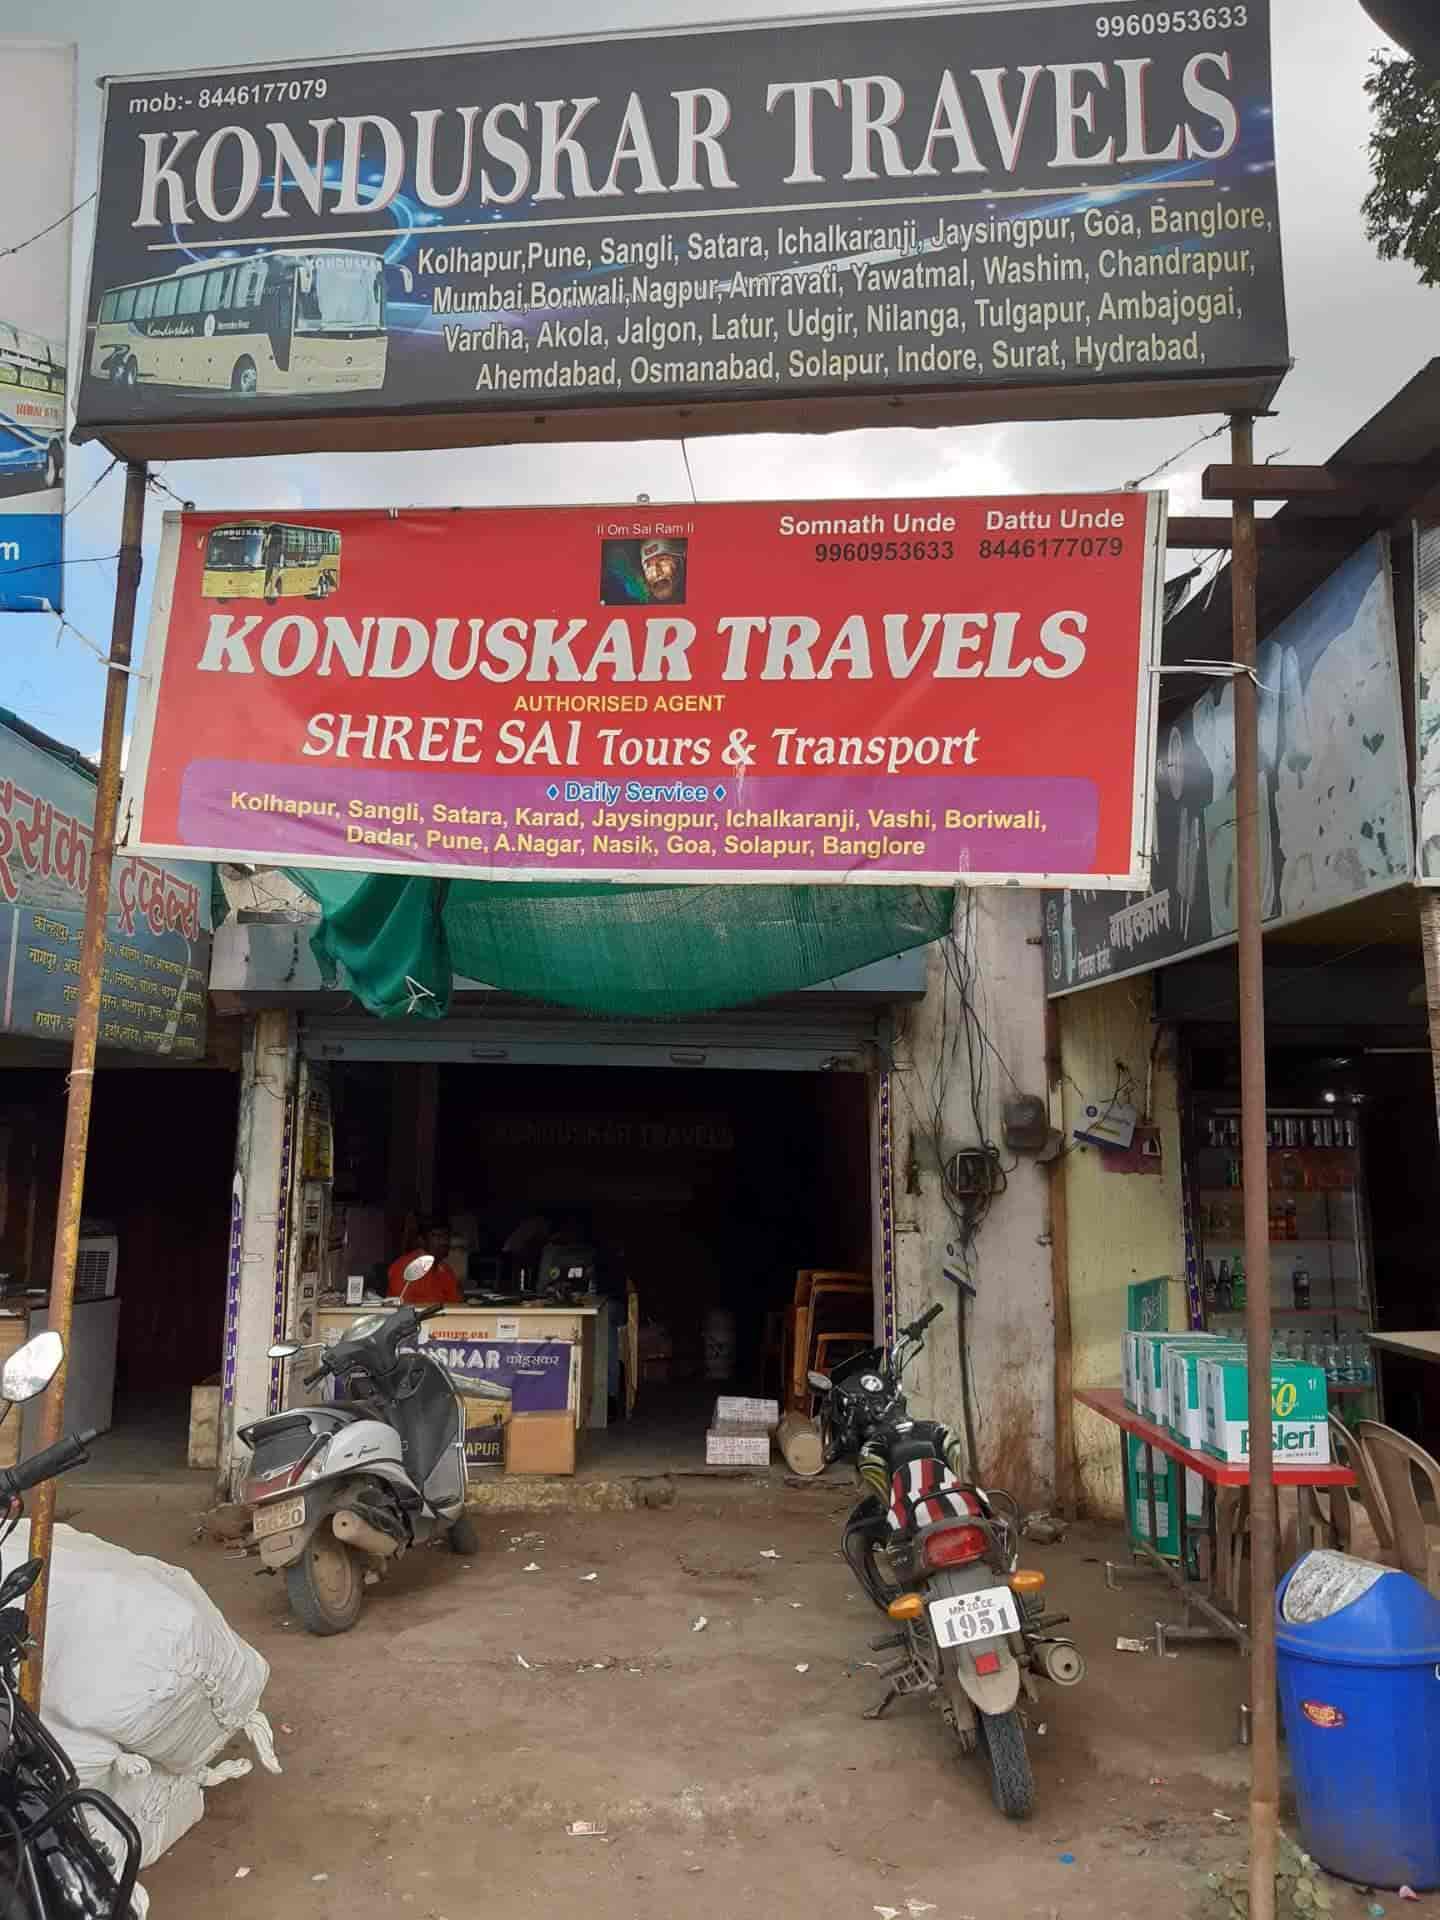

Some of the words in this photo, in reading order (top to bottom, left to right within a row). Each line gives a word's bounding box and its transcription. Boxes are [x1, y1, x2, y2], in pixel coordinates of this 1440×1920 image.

[1095, 4, 1249, 40] 9960953633
[198, 78, 328, 110] 8446177079
[131, 86, 739, 230] KONDUSKAR
[765, 49, 1240, 184] TRAVELS
[600, 235, 679, 269] Sangli,
[687, 232, 769, 260] Satara,
[777, 220, 923, 256] Ichalkaranji,
[932, 216, 1076, 249] Jaysingpur,
[1084, 208, 1142, 239] Goa,
[1151, 203, 1272, 237] Banglore,
[729, 263, 844, 298] Amravati,
[852, 259, 976, 292] Yawatmal,
[984, 253, 1090, 285] Washim,
[1099, 247, 1255, 280] Chandrapur,
[444, 323, 529, 353] Vardha,
[537, 320, 609, 349] Akola,
[617, 316, 703, 349] Jalgon,
[712, 314, 778, 342] Latur,
[787, 307, 858, 342] Udgir,
[867, 304, 966, 337] Nilanga,
[974, 297, 1090, 333] Tulgapur,
[1098, 287, 1242, 325] Ambajogai,
[476, 358, 622, 391] Ahemdabad,
[630, 351, 781, 383] Osmanabad,
[789, 349, 889, 381] Solapur,
[898, 344, 983, 375] Indore,
[992, 339, 1066, 370] Surat,
[1075, 331, 1205, 372] Hydrabad,
[608, 524, 629, 535] Om
[632, 523, 652, 535] Sai
[656, 523, 684, 533] Ram
[779, 514, 885, 536] Somnath
[893, 513, 956, 533] Unde
[986, 510, 1050, 530] Dattu
[1060, 509, 1125, 528] Unde
[815, 541, 954, 562] 9960953633
[979, 537, 1123, 559] 8446177079
[197, 614, 697, 682] KONDUSKAR
[717, 610, 1088, 681] TRAVELS
[514, 695, 648, 712] AUTHORISED
[654, 695, 725, 712] AGENT
[302, 713, 483, 763] SHREE
[495, 719, 582, 765] SAI
[597, 729, 712, 765] Tours
[721, 728, 757, 766] &
[771, 728, 979, 774] Transport
[231, 791, 340, 819] Kolhapur,
[348, 800, 425, 824] Sangli,
[432, 804, 508, 828] Satara,
[515, 808, 584, 829] Karad,
[591, 809, 719, 832] Jaysingpur,
[725, 809, 860, 832] Ichalkaranji,
[867, 809, 937, 831] Vashi,
[945, 809, 1048, 832] Boriwali,
[565, 781, 621, 806] Daily
[626, 781, 708, 801] Service
[347, 825, 419, 849] Dadar,
[426, 830, 488, 853] Pune,
[593, 835, 659, 855] Nasik,
[667, 835, 716, 856] Goa,
[724, 835, 815, 857] Solapur,
[823, 835, 926, 858] Banglore
[944, 1607, 1011, 1643] 1951
